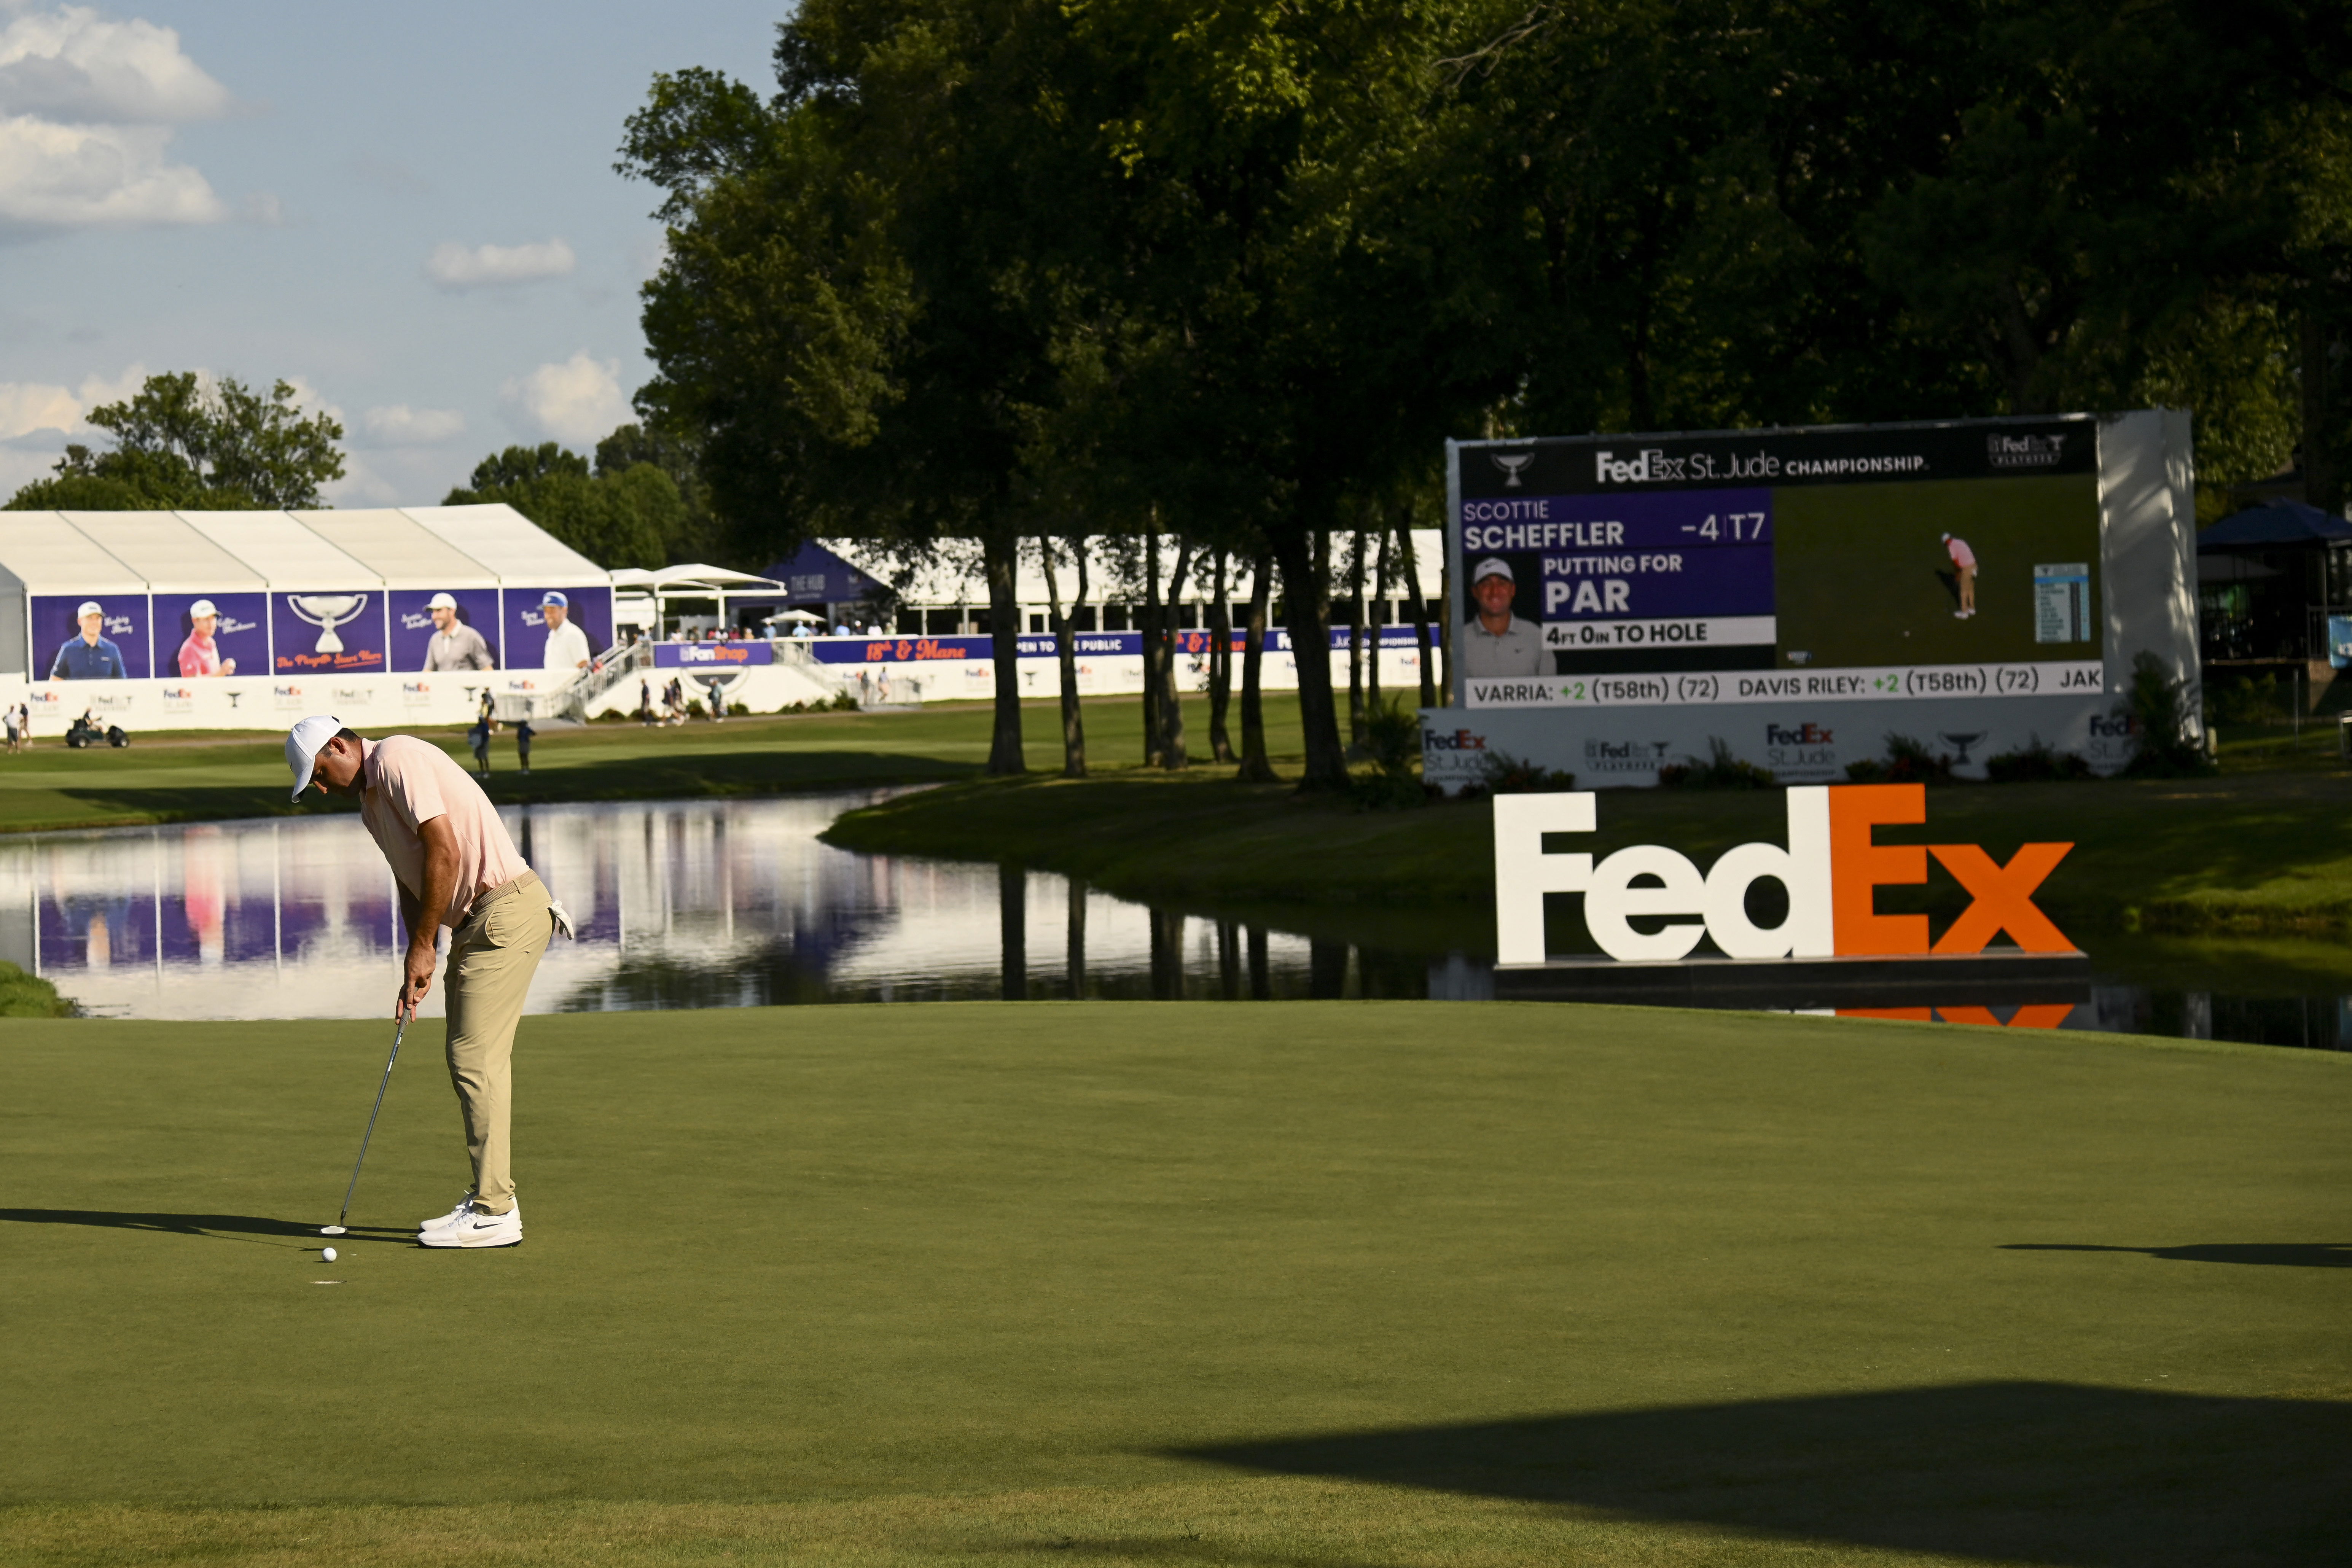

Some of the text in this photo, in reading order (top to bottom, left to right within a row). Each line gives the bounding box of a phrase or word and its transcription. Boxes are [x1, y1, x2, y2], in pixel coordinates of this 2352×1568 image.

[1596, 449, 1924, 483] FedEx St. Jude CHAMPIONSHIP
[1463, 500, 1549, 521] SCOTTIE
[1465, 522, 1624, 550] SCHEFFLER
[1682, 513, 1765, 542] -4 T7
[1543, 554, 1682, 576] PUTTING FOR
[791, 574, 825, 591] THE HUB
[1546, 579, 1630, 614] PAR
[1613, 625, 1644, 643] TO
[1650, 623, 1707, 642] HOLE
[896, 640, 912, 661] &
[915, 640, 966, 660] Mane
[1016, 641, 1056, 653] EN TO
[1081, 639, 1122, 651] PUBLIC
[275, 686, 302, 696] FedEx
[403, 683, 429, 692] FedEx
[1474, 667, 2099, 703] VARRIA: +2 (T58th) (72) DAVIS RILEY: +2 (T58th) (72) JAK
[1767, 723, 1833, 745] FedEx
[2089, 715, 2137, 737] Fed
[1425, 729, 1486, 750] FedEx
[1493, 783, 2079, 963] FedEx
